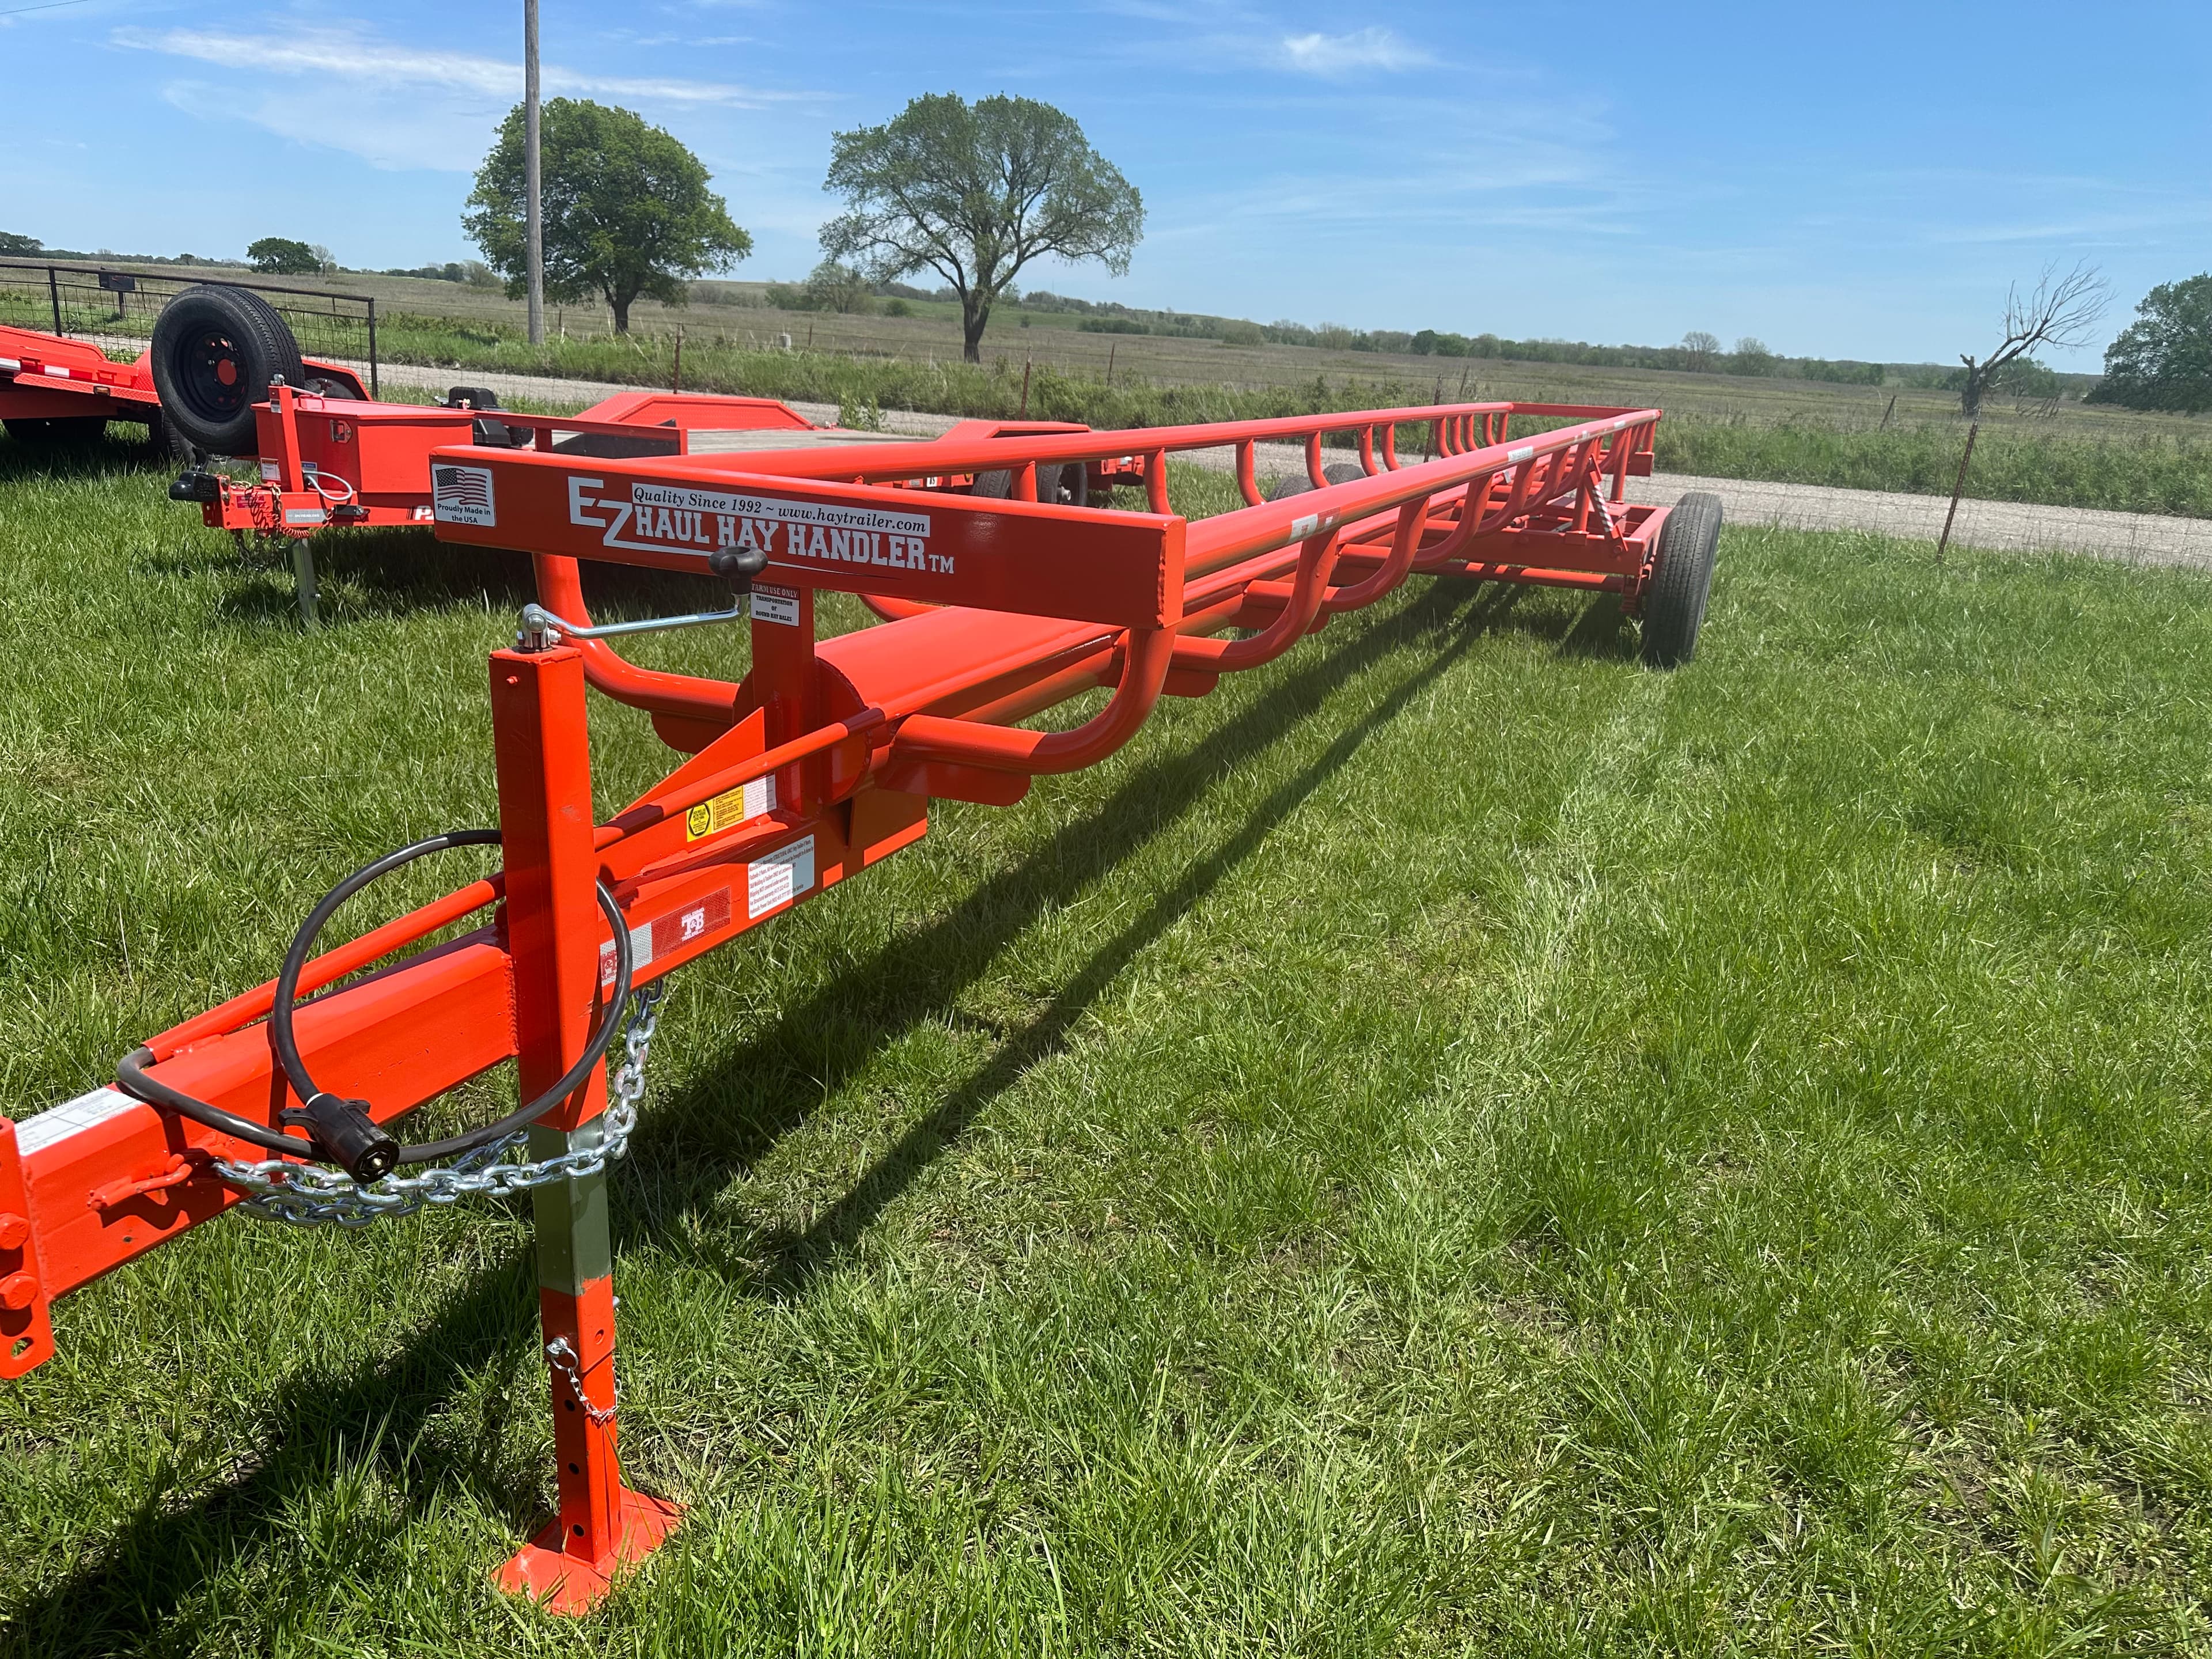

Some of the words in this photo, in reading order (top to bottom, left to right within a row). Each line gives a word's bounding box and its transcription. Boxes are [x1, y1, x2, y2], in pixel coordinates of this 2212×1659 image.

[437, 503, 463, 514] Proudly
[464, 506, 483, 516] Made
[568, 476, 634, 547] EZ
[634, 487, 684, 507] Quality
[688, 493, 726, 510] Since
[730, 499, 762, 513] 1992
[778, 507, 926, 532] www.haytrailer.com
[452, 515, 463, 523] the
[464, 516, 478, 524] USA
[635, 505, 710, 544] HAUL
[718, 516, 779, 552] HAY
[787, 524, 926, 570] HANDLER
[929, 554, 955, 574] TM
[769, 586, 781, 595] USE
[782, 589, 797, 599] ONLY
[756, 595, 793, 606] TRANSPORTATION
